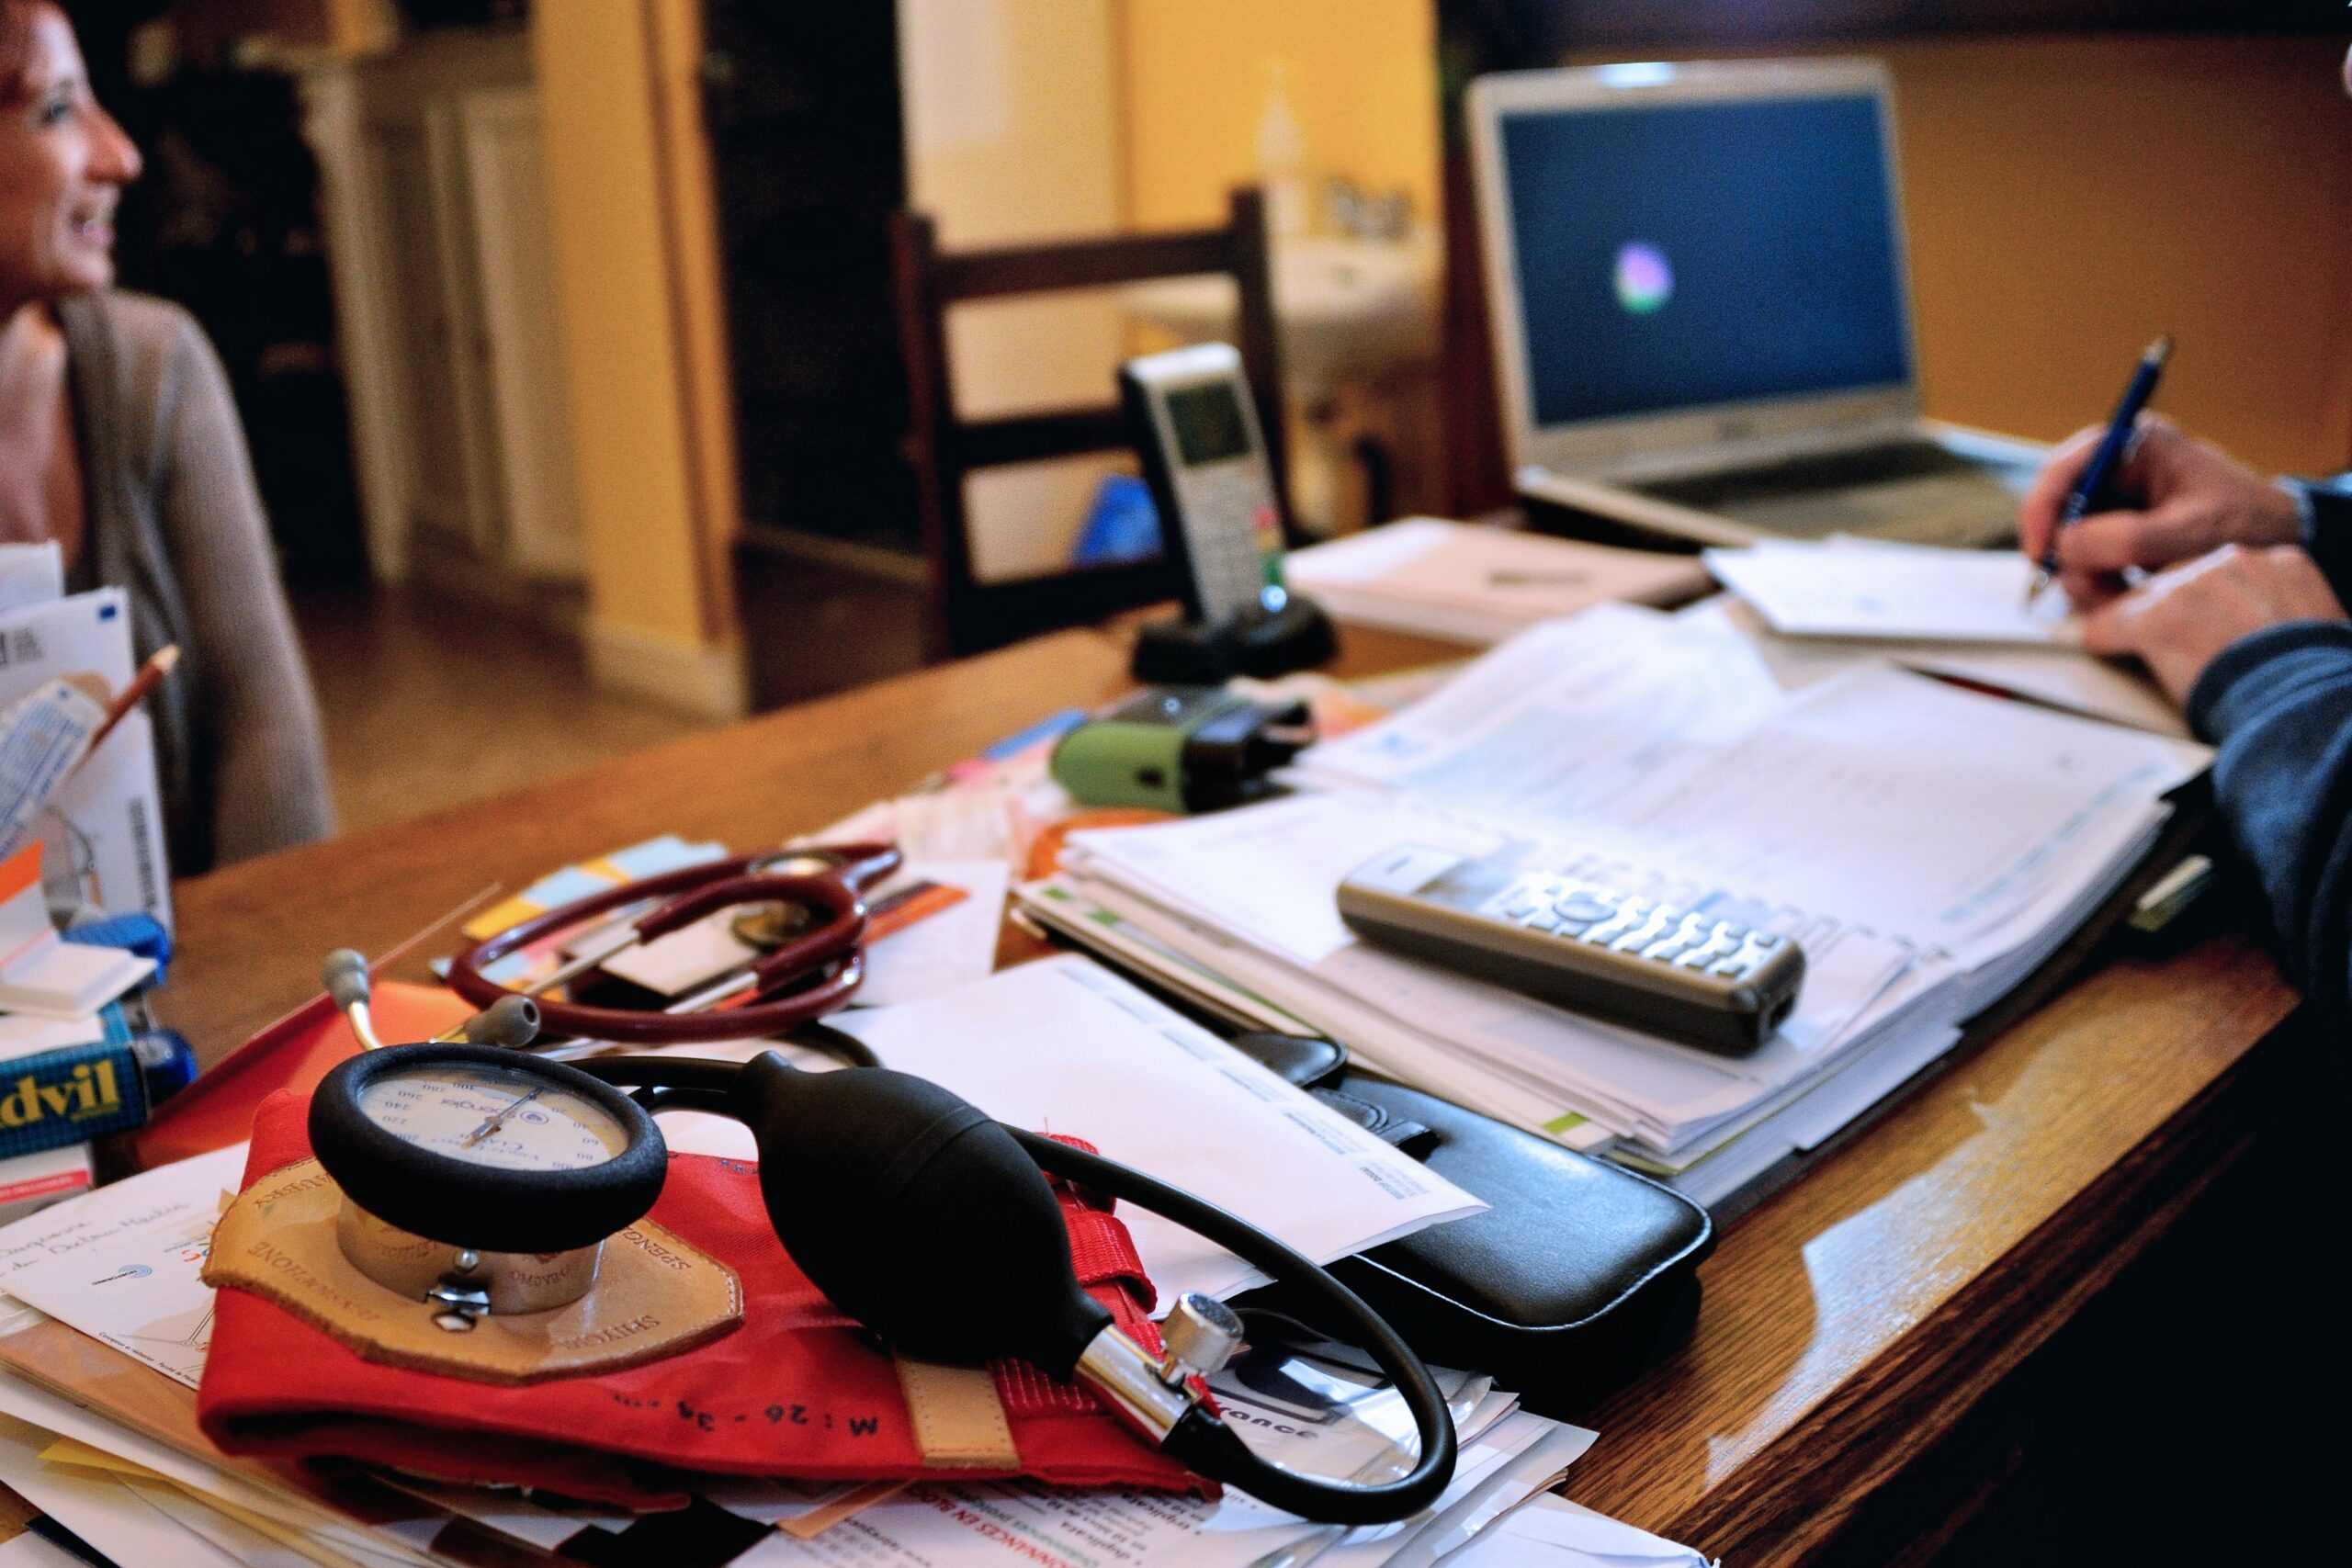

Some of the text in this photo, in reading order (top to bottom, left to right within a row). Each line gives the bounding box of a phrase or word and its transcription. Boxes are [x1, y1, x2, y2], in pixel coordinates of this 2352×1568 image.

[423, 1083, 446, 1093] 280
[0, 1059, 120, 1128] dvil
[398, 1090, 423, 1100] 260
[385, 1101, 411, 1111] 240
[382, 1115, 407, 1125] 220
[573, 1122, 590, 1130] 40
[577, 1153, 594, 1161] 80
[765, 1404, 808, 1425] 26
[849, 1416, 878, 1437] M
